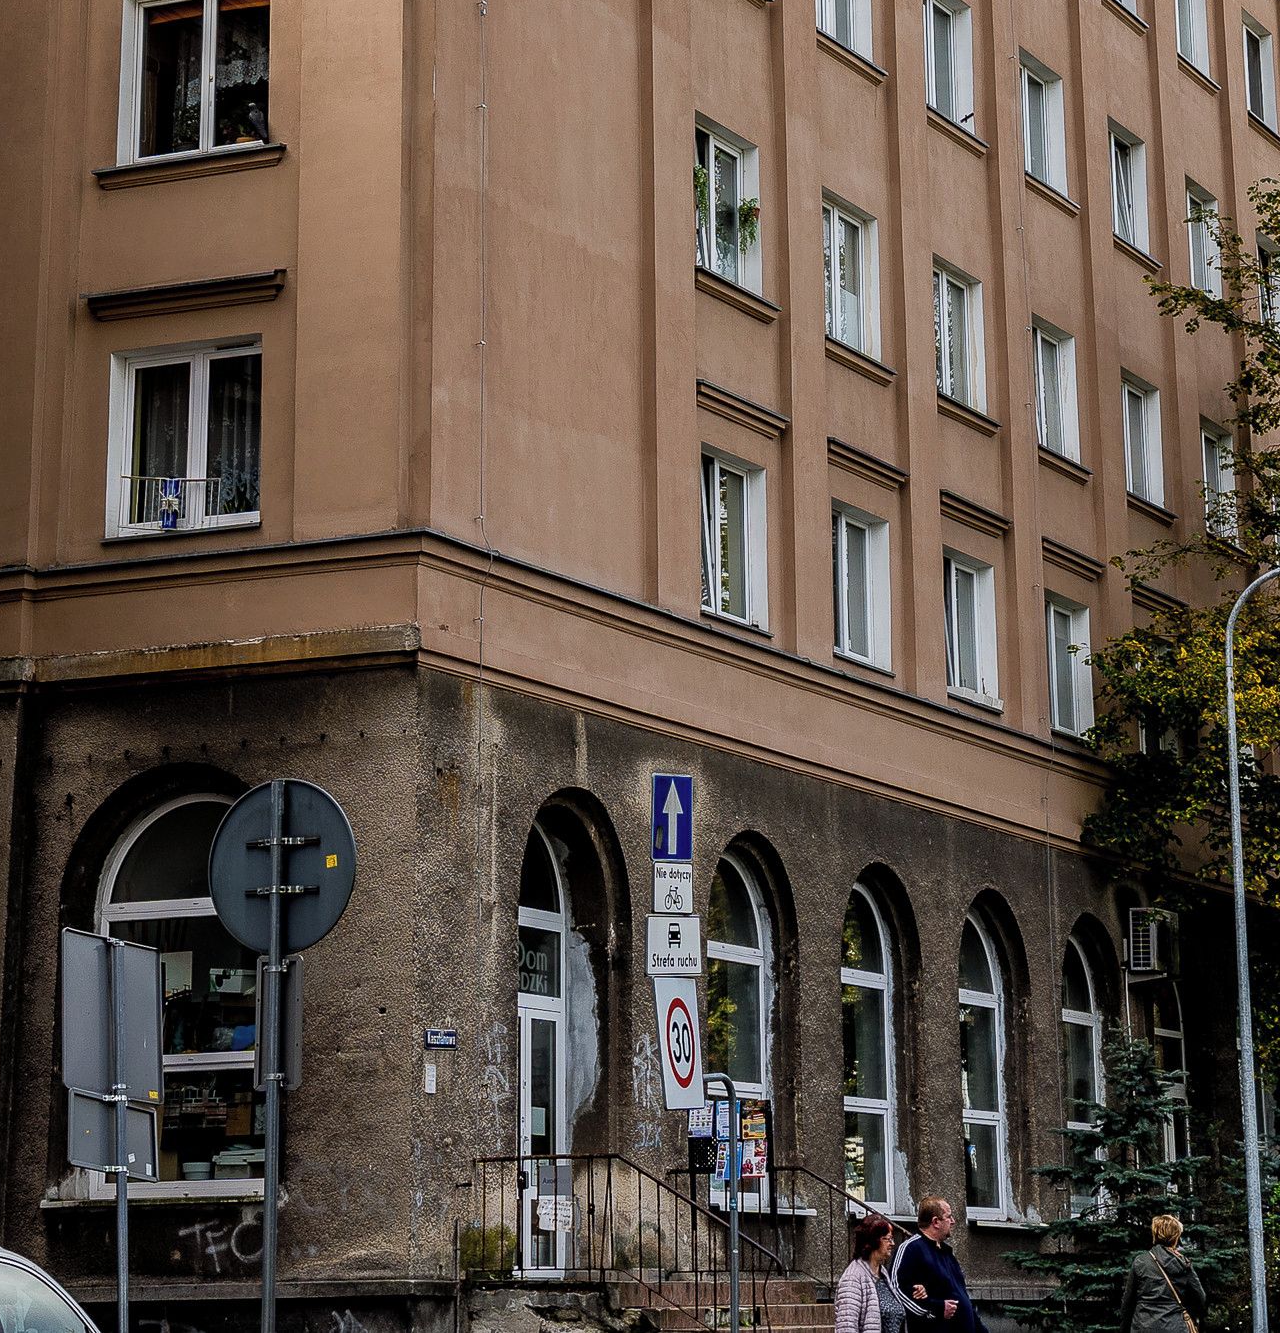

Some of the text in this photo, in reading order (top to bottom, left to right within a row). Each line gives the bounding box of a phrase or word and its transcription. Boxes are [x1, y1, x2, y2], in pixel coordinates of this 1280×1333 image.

[656, 866, 691, 883] Nie dotyczy
[652, 952, 698, 968] Strefa ruchu
[672, 1021, 691, 1064] 30
